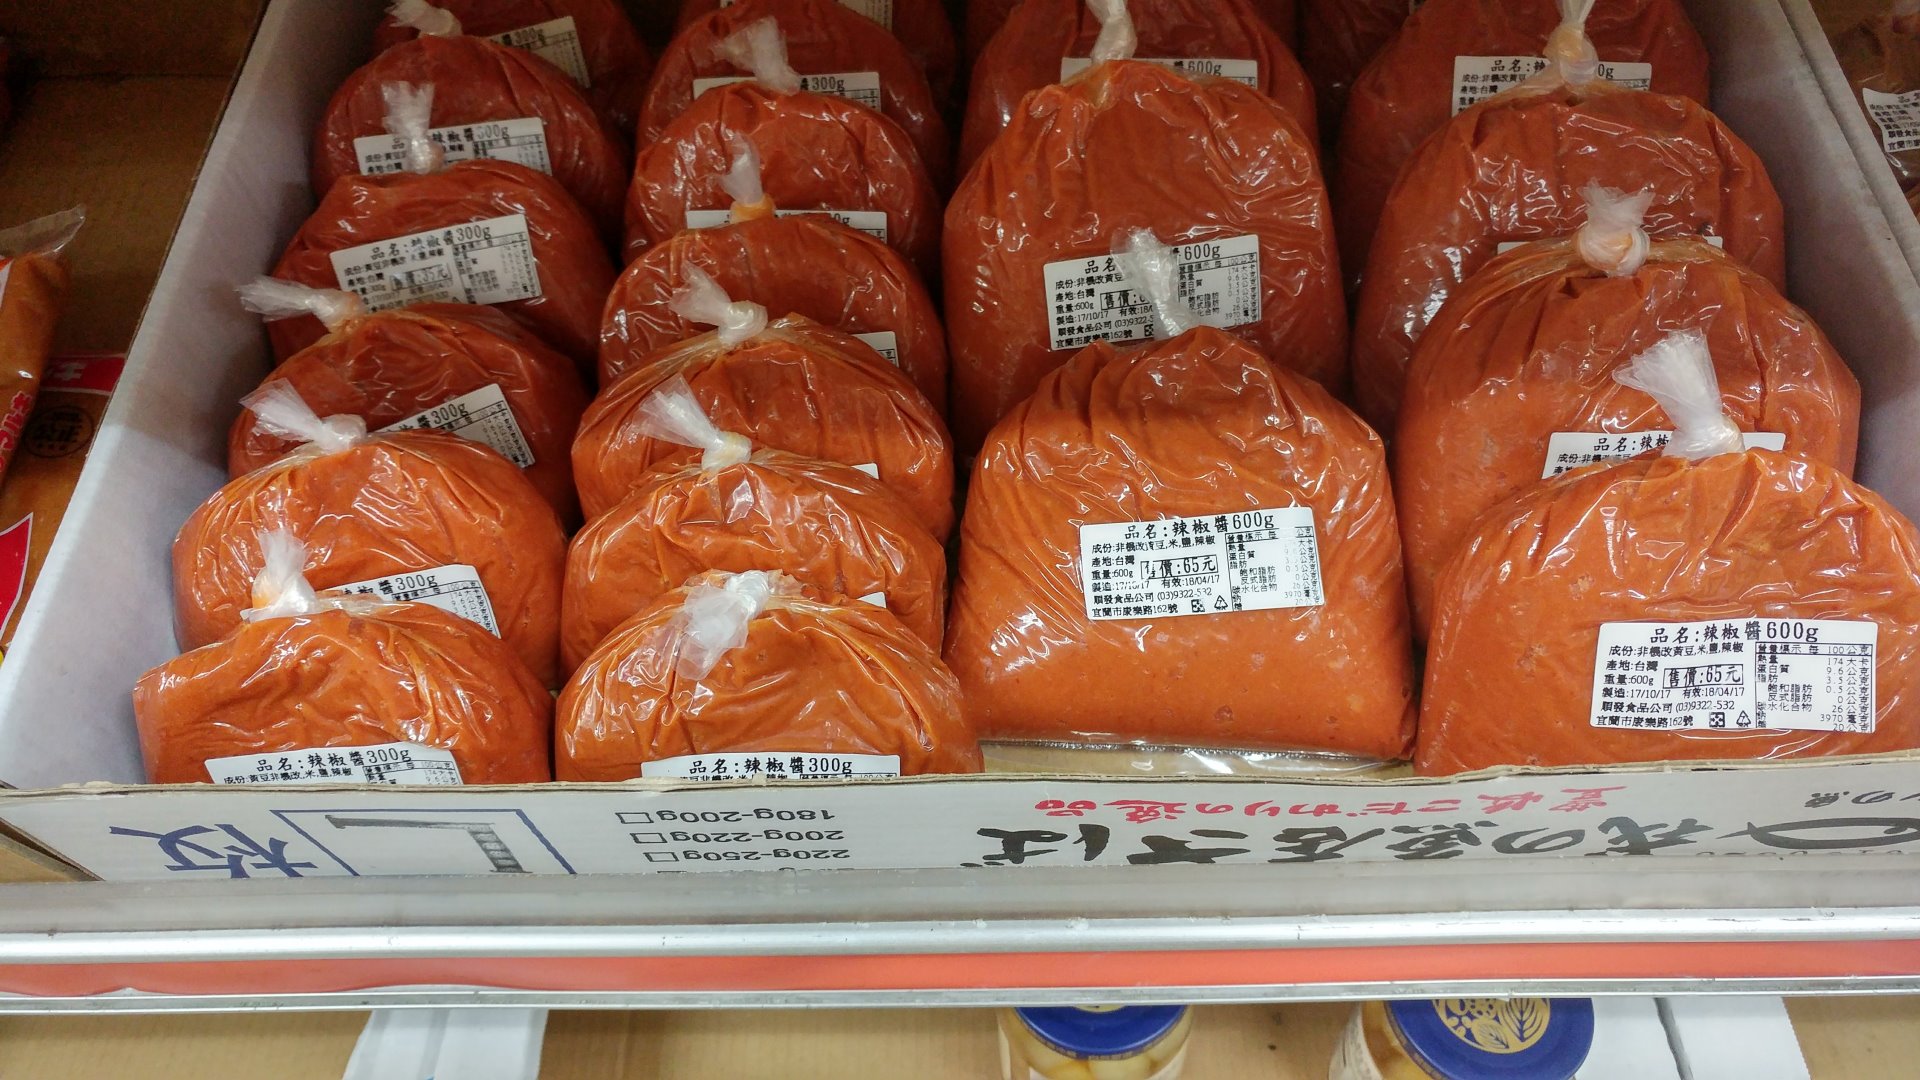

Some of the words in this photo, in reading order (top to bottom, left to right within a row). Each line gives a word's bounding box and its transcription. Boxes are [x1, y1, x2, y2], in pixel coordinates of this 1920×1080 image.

[1597, 64, 1614, 79] 0g
[1056, 302, 1094, 314] 重量:600g
[1114, 315, 1154, 329] (03)9322-5
[1092, 555, 1135, 567] 產地:台灣
[1091, 569, 1133, 581] 重量:600g
[1758, 644, 1801, 655] 營養標示
[1606, 660, 1659, 671] 產地:台灣
[1758, 655, 1778, 664] 熱量
[1757, 665, 1789, 673] 蛋白質
[1604, 674, 1654, 686] 重量:600g
[1669, 665, 1741, 687] 售價:65元
[1602, 687, 1671, 698] 製造:17/10/17
[1682, 686, 1745, 698] 有效:18/04/17
[1676, 700, 1735, 712] (03)9322-532
[1596, 715, 1694, 728] 宜蘭市康樂路162號
[656, 808, 836, 823] 180g-200g
[669, 829, 845, 843] 200g-220g
[683, 848, 851, 861] 220g-250g
